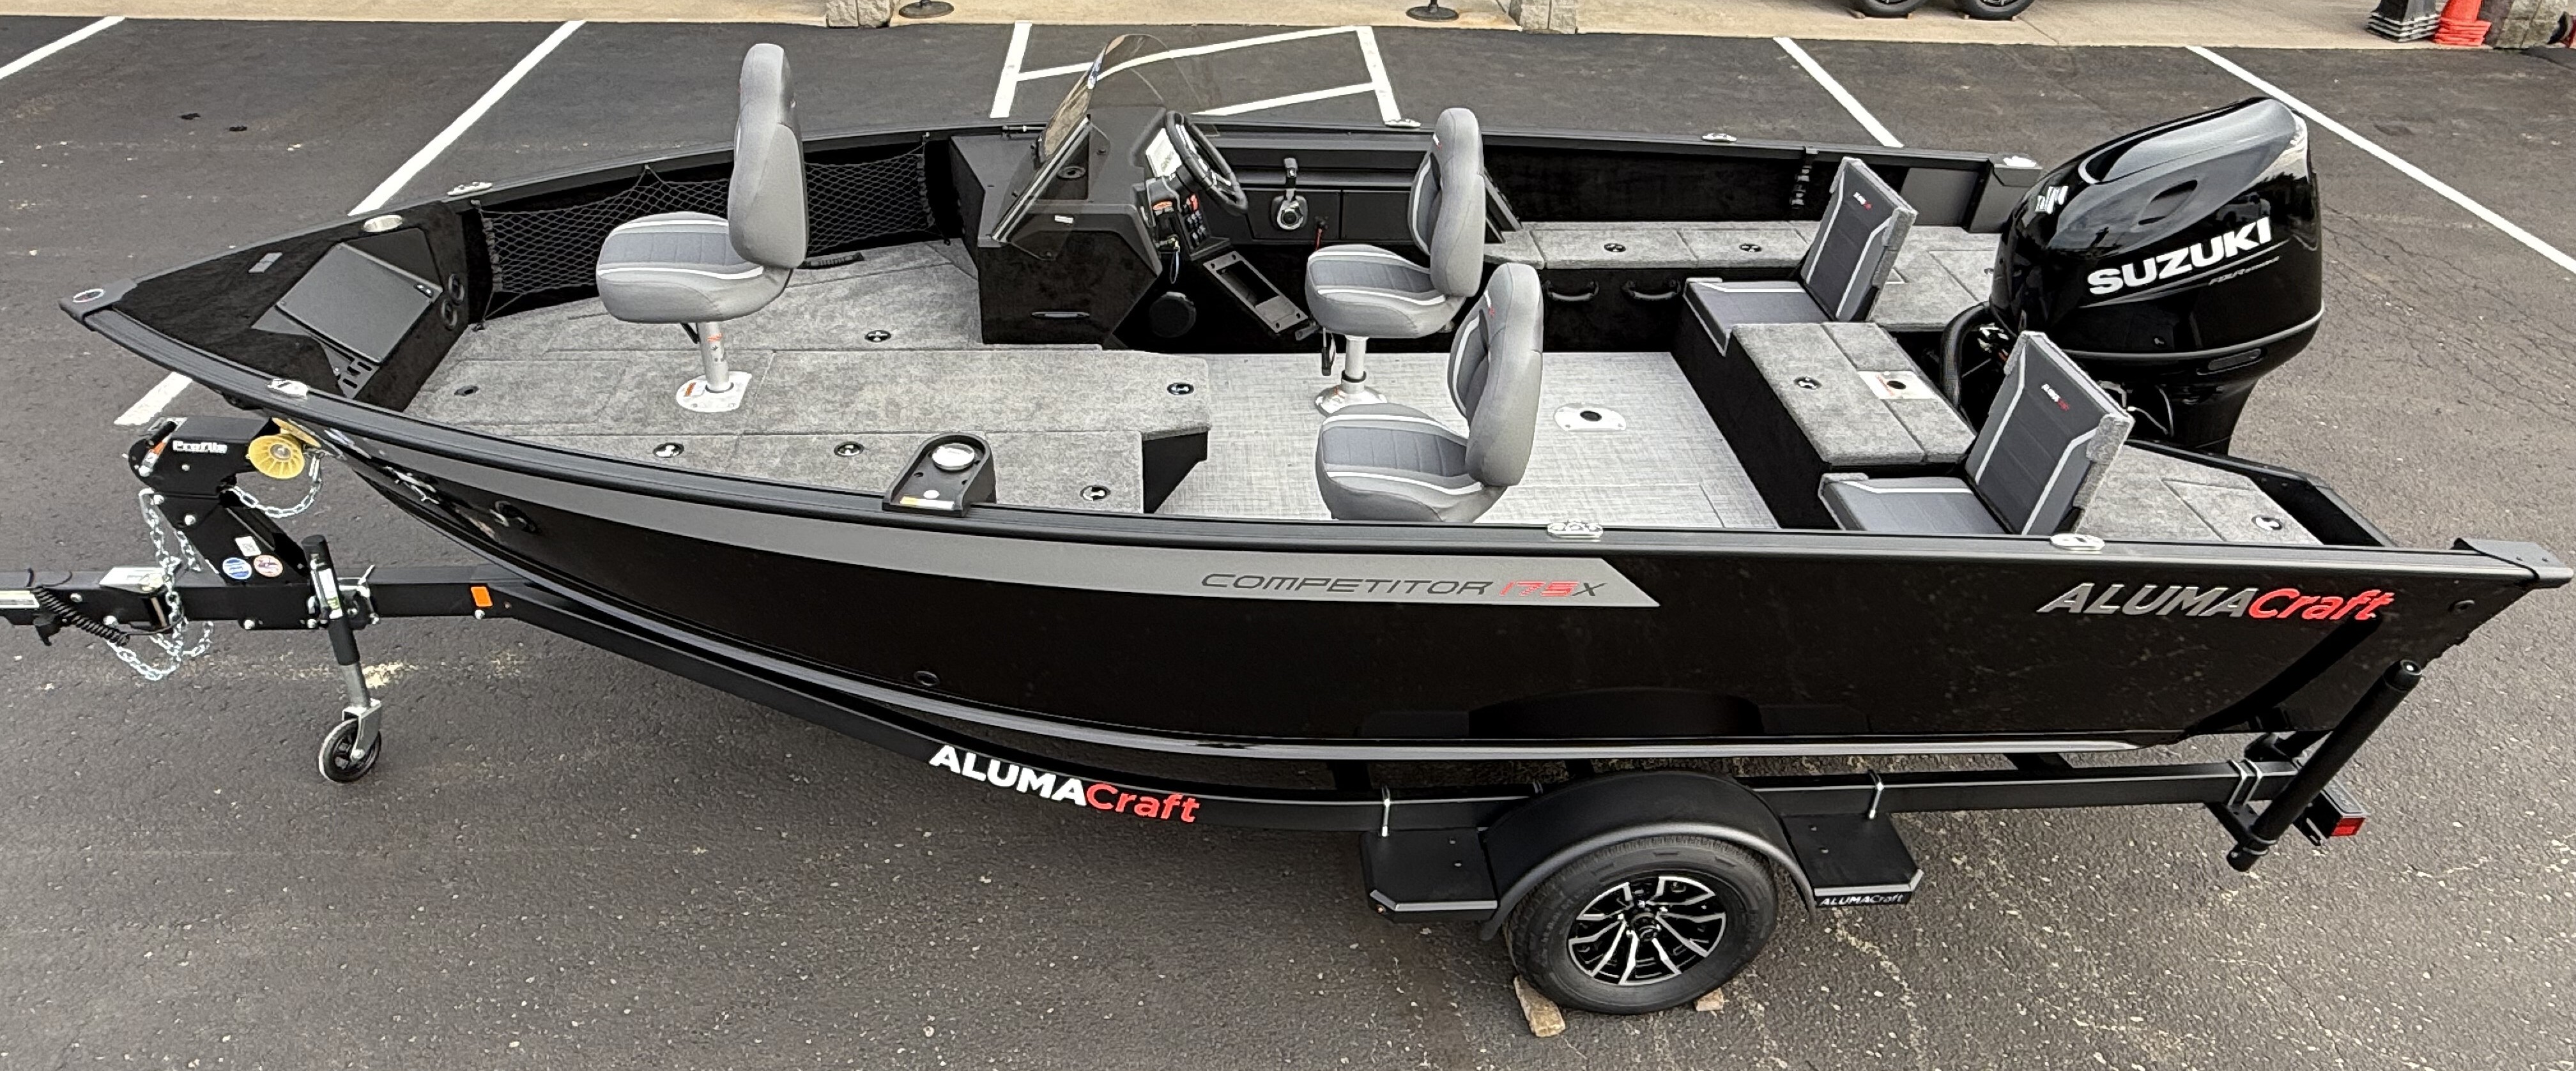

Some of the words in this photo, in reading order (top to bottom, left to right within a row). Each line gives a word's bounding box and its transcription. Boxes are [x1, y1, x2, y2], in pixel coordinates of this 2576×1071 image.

[2087, 216, 2272, 295] SUZUKI
[1201, 573, 1493, 595] COMPETITOR
[2036, 582, 2395, 621] ALUMACraft
[928, 745, 1200, 823] ALUMACraft
[1819, 893, 1904, 906] ALUMACraft
